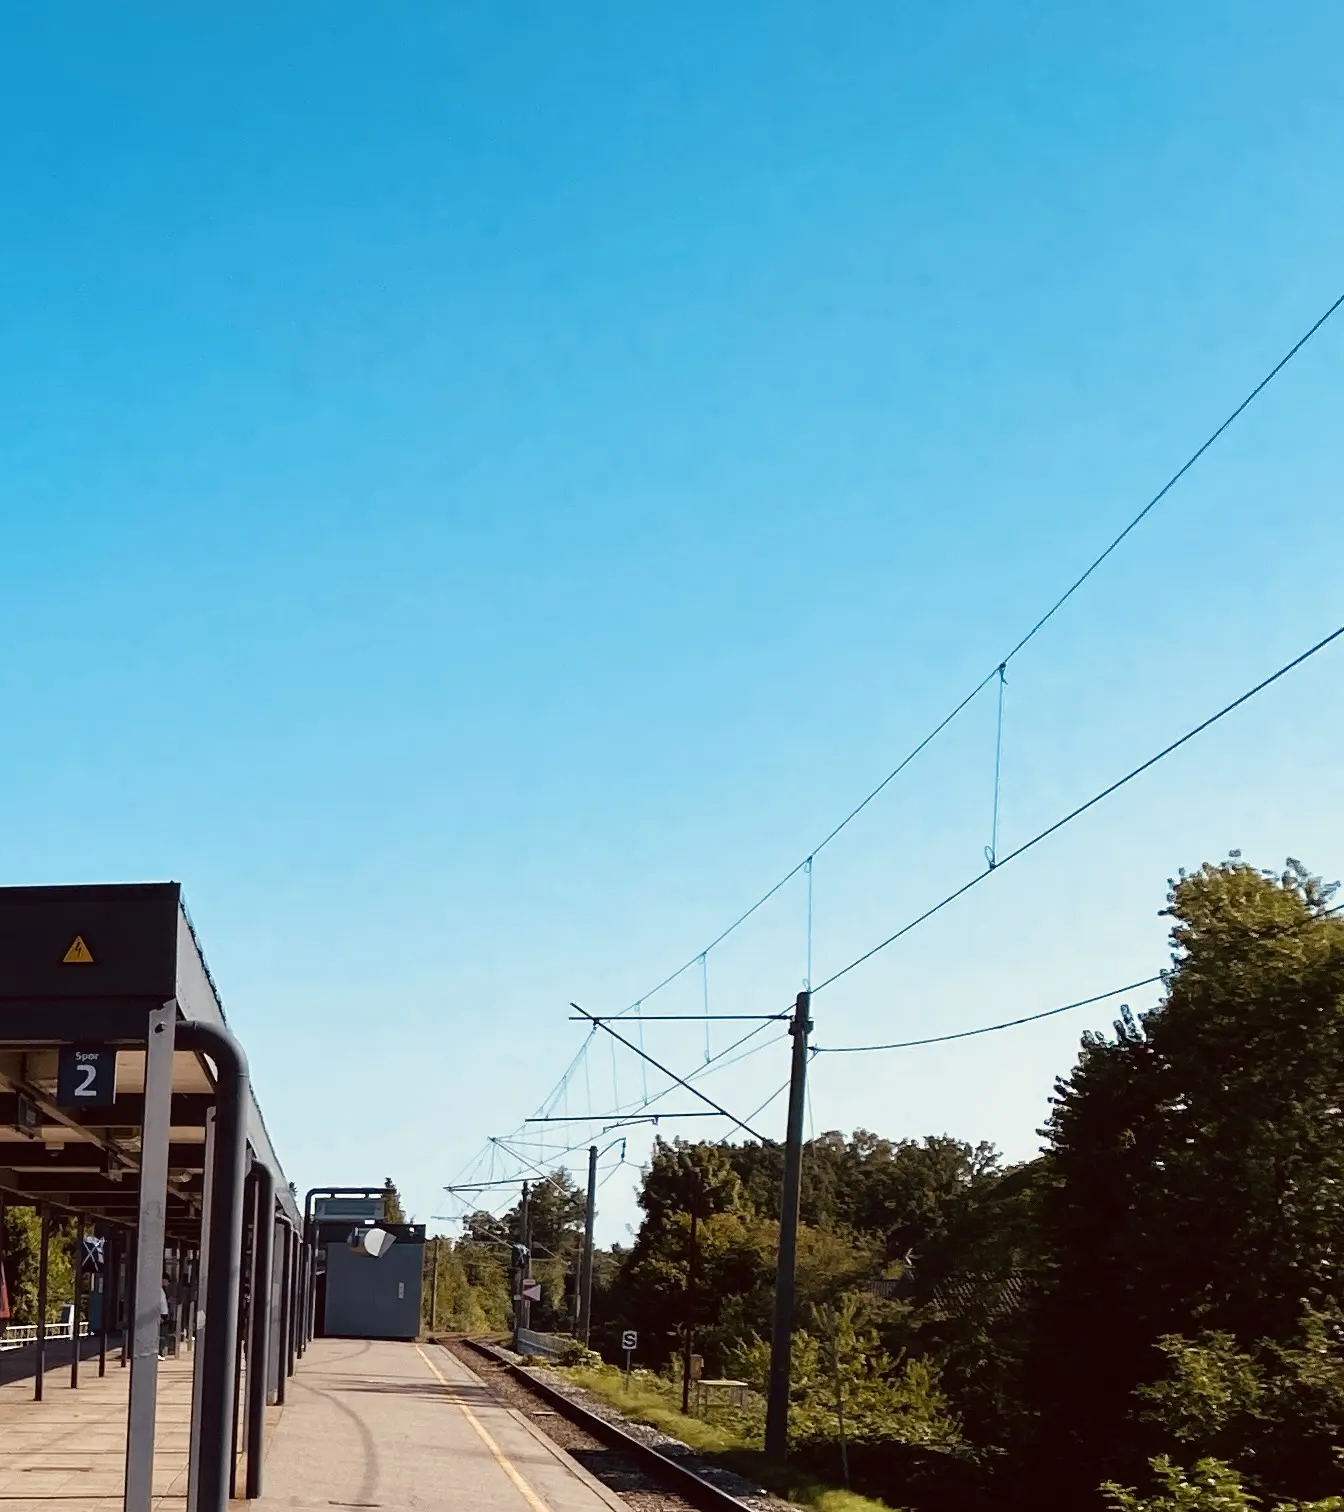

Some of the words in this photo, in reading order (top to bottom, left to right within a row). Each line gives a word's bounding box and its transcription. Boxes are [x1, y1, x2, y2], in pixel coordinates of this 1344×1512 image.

[75, 1051, 100, 1062] Spor
[74, 1064, 97, 1097] 2
[624, 1333, 636, 1347] S
